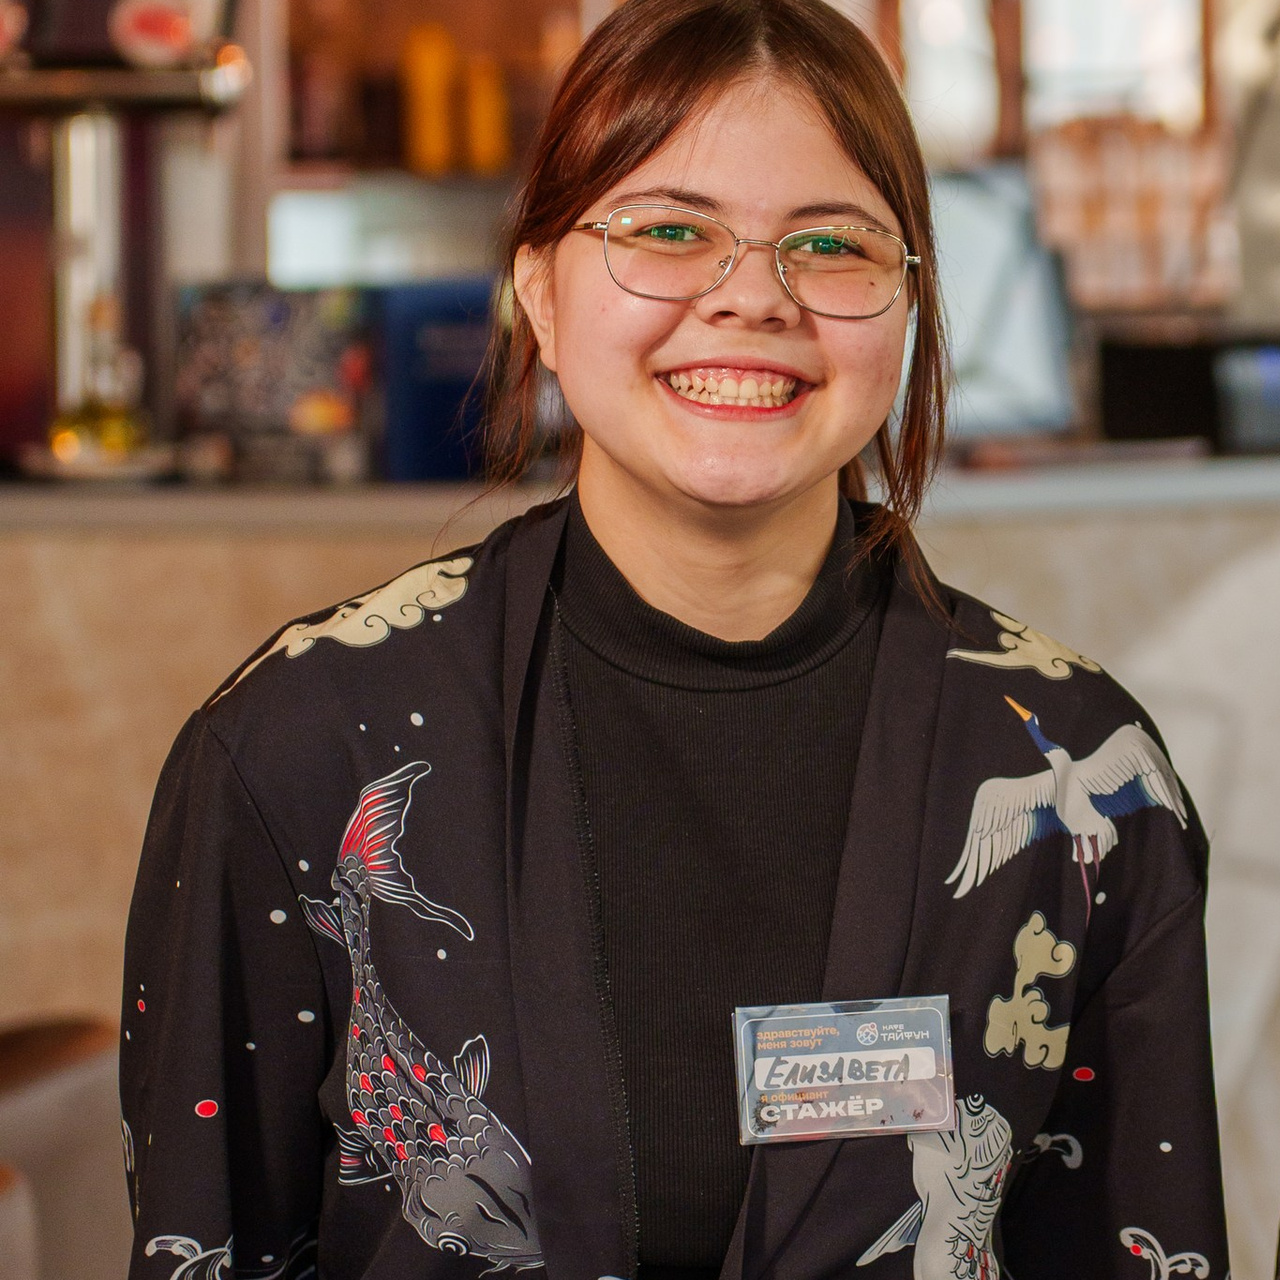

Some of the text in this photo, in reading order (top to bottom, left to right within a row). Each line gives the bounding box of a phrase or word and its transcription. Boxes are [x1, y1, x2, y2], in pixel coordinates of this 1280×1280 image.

[756, 1026, 840, 1041] здравствуйте,
[880, 1030, 930, 1042] ТАЙФУН
[757, 1039, 822, 1051] меня зовут
[764, 1054, 910, 1088] ЕЛИЗАВЕТА
[760, 1091, 828, 1103] я официант
[759, 1095, 884, 1122] СТАЖЁР
